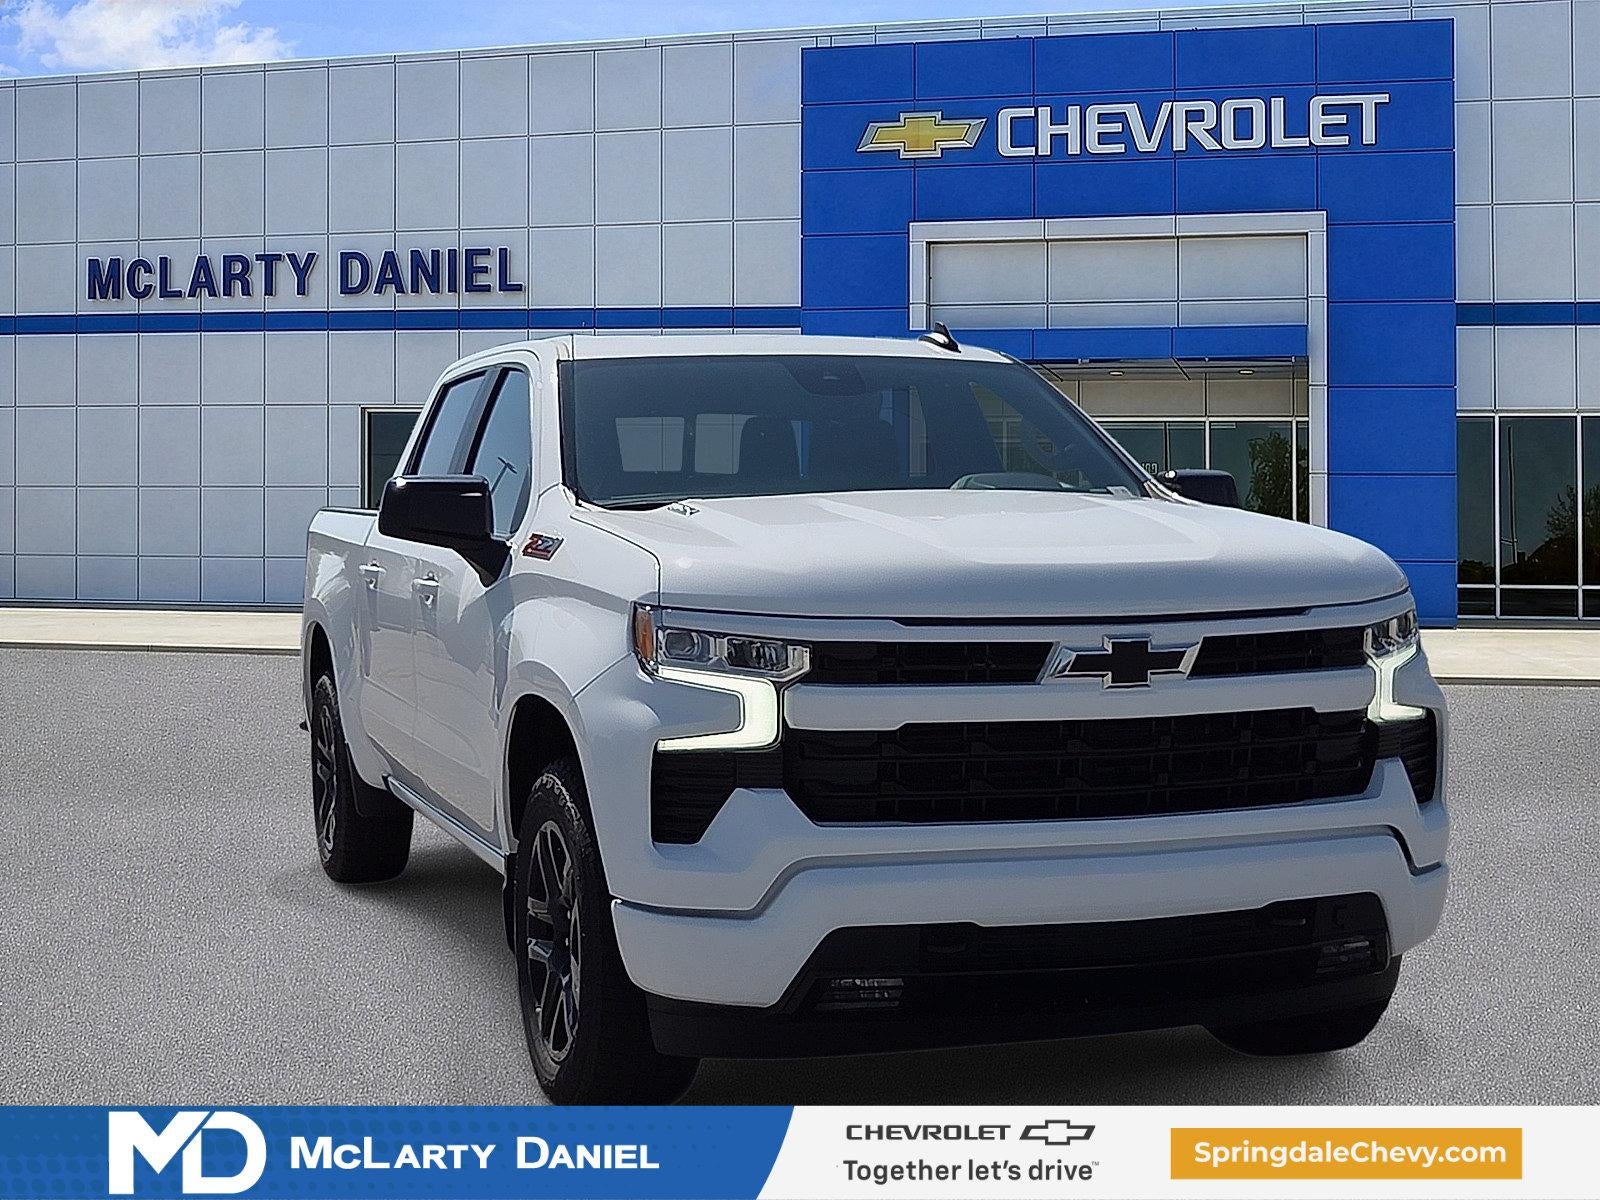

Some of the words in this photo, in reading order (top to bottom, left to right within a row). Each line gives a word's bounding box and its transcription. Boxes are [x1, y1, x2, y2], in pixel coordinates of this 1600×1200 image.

[997, 93, 1390, 156] CHEVROLET
[87, 252, 318, 300] MCLARTY
[339, 247, 525, 296] DANIEL
